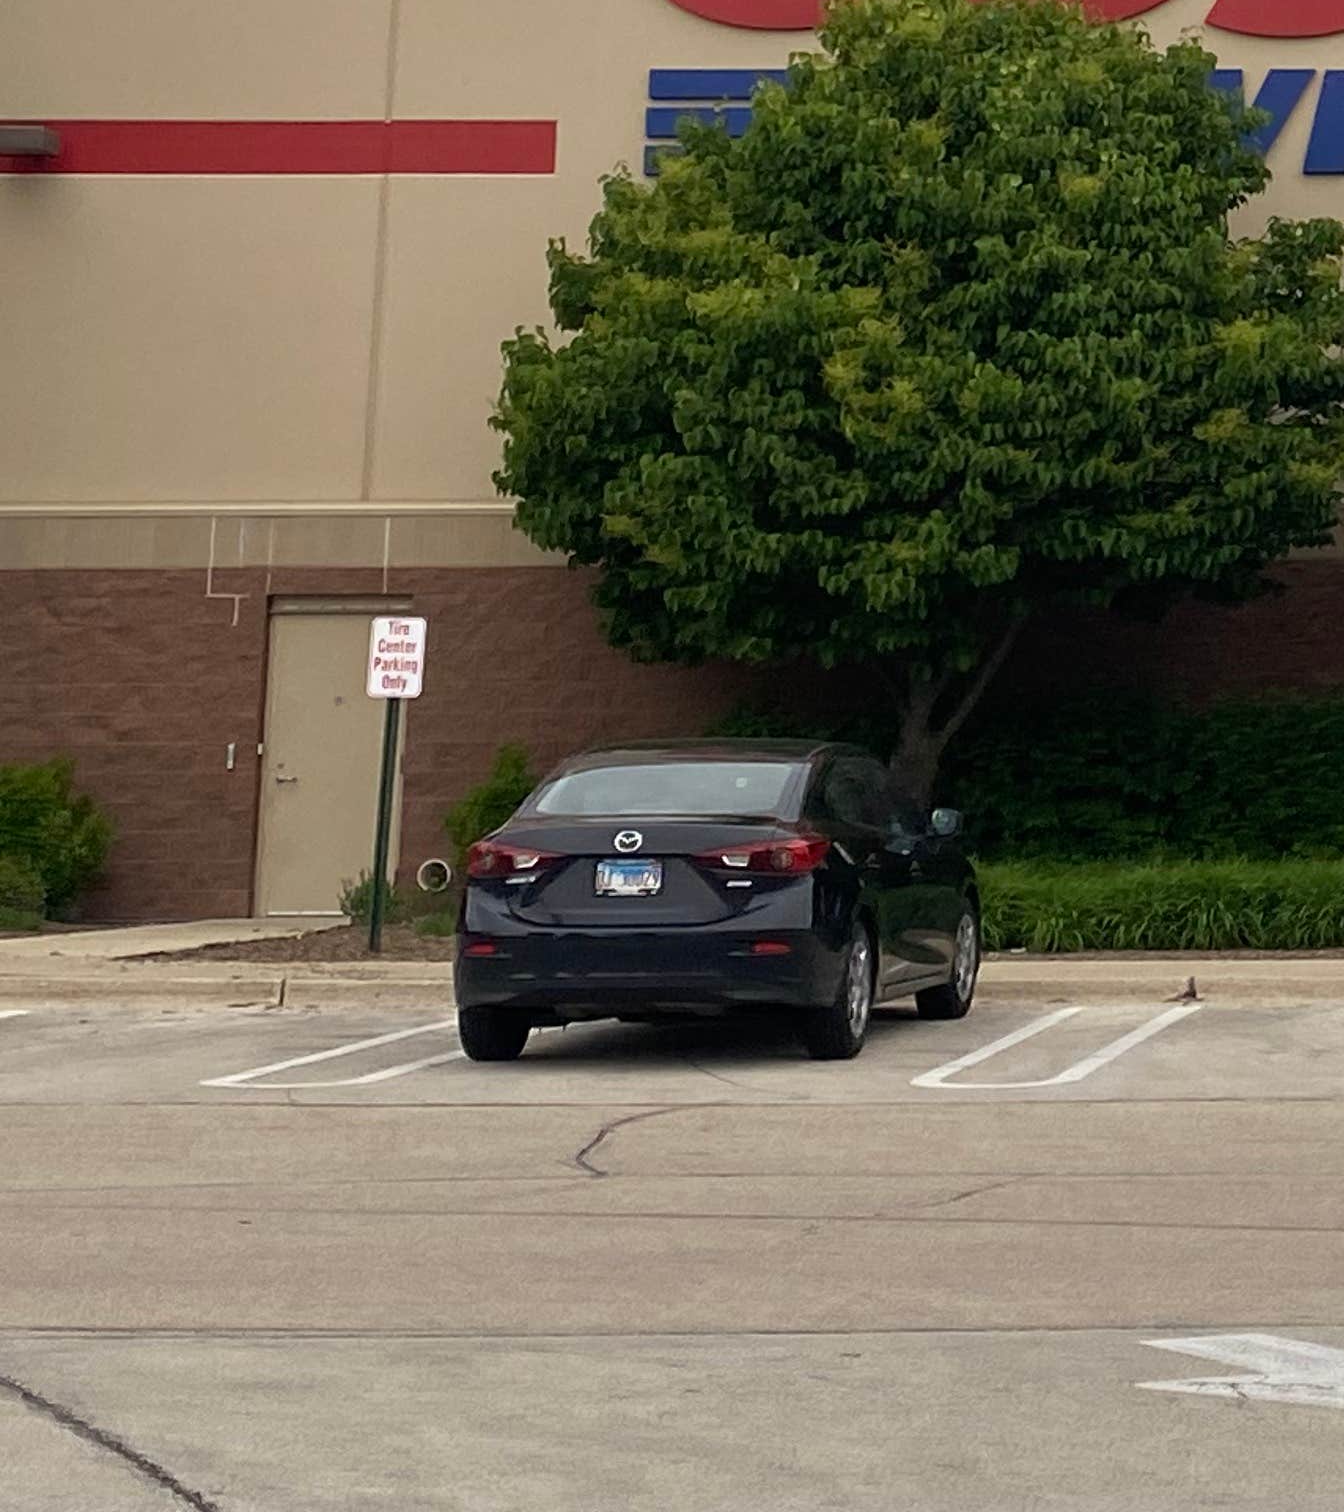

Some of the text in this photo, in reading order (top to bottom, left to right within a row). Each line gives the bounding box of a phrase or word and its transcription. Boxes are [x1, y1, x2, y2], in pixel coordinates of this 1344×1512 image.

[388, 620, 410, 636] Tire
[378, 638, 417, 653] Center
[373, 656, 418, 674] Parking
[382, 674, 407, 692] Only
